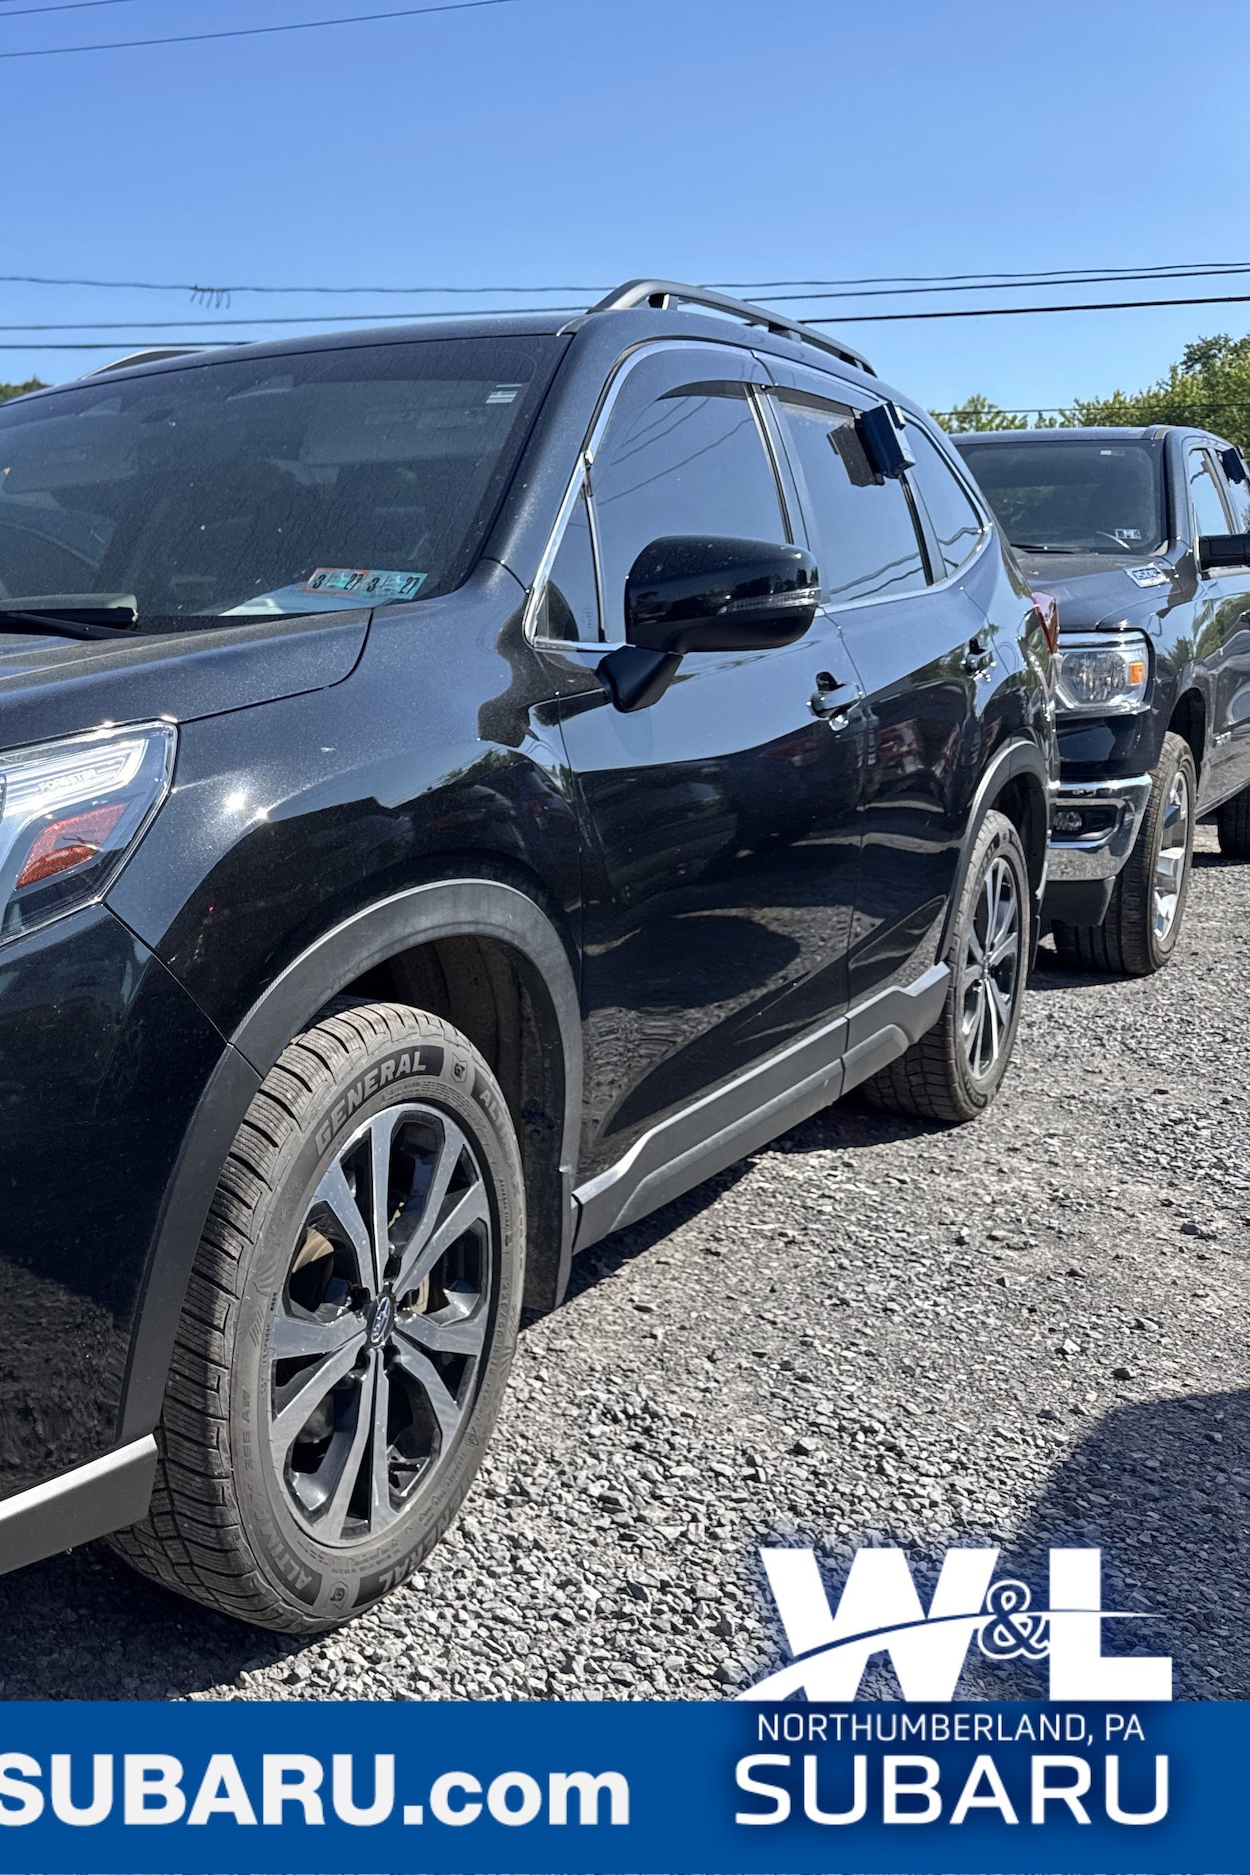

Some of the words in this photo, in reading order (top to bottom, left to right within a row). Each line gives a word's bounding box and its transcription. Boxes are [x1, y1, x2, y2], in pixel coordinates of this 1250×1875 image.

[312, 574, 327, 589] 3
[343, 573, 365, 591] 27
[366, 577, 380, 593] 3
[398, 576, 420, 595] 27
[315, 1051, 427, 1156] GENERAL
